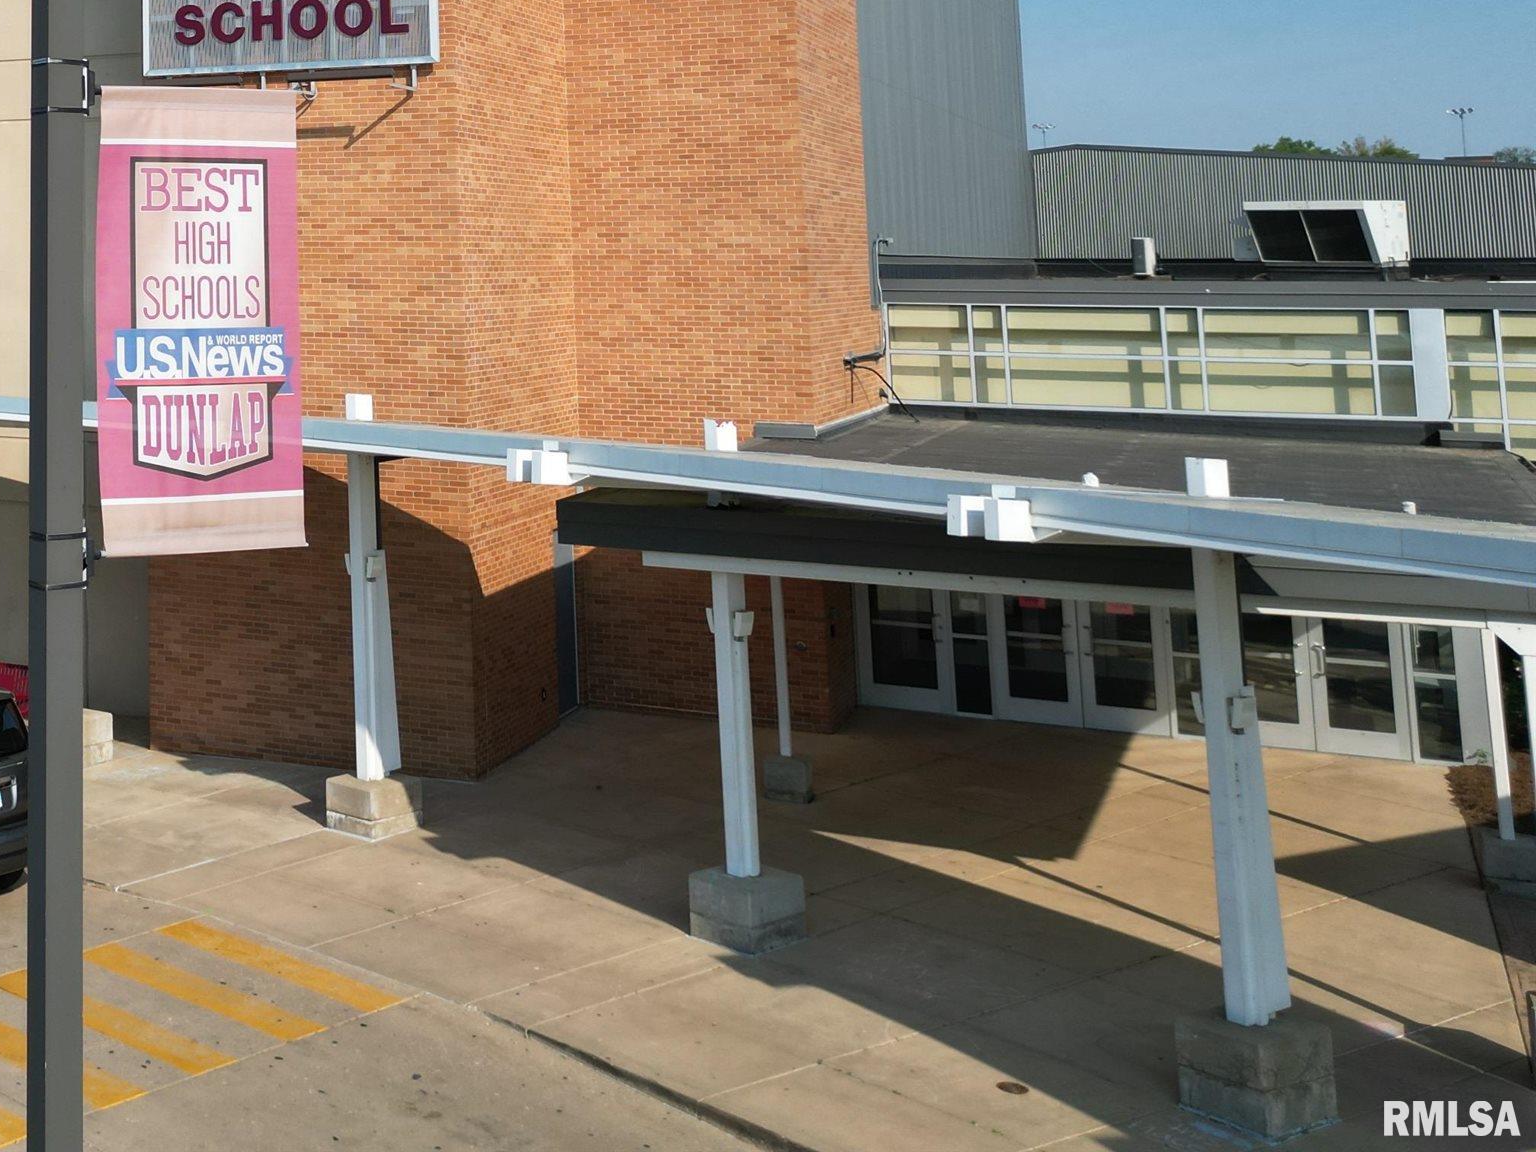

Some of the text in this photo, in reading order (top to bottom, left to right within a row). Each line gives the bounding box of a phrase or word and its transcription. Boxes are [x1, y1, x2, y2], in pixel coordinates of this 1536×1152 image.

[140, 167, 260, 213] BEST
[174, 221, 232, 265] HIGH
[142, 275, 261, 321] SCHOOLS
[207, 333, 284, 345] & WORLD REPORT
[141, 392, 265, 466] DUNLAP
